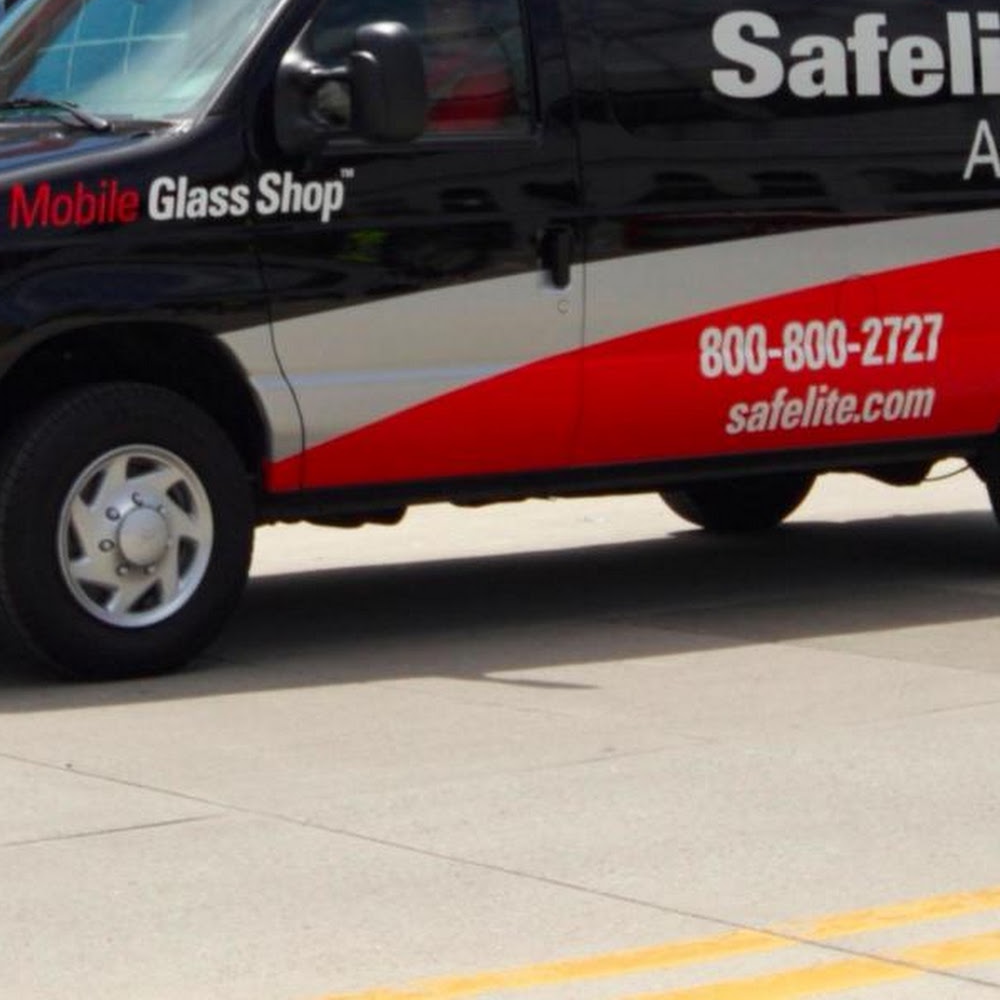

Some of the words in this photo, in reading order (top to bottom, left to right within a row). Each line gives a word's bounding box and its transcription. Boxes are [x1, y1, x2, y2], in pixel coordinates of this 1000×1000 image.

[711, 10, 1000, 98] Safeli
[8, 180, 140, 230] Mobile
[148, 175, 250, 221] Glass
[699, 313, 944, 378] 800-800-2727
[725, 384, 936, 435] safelite.com
